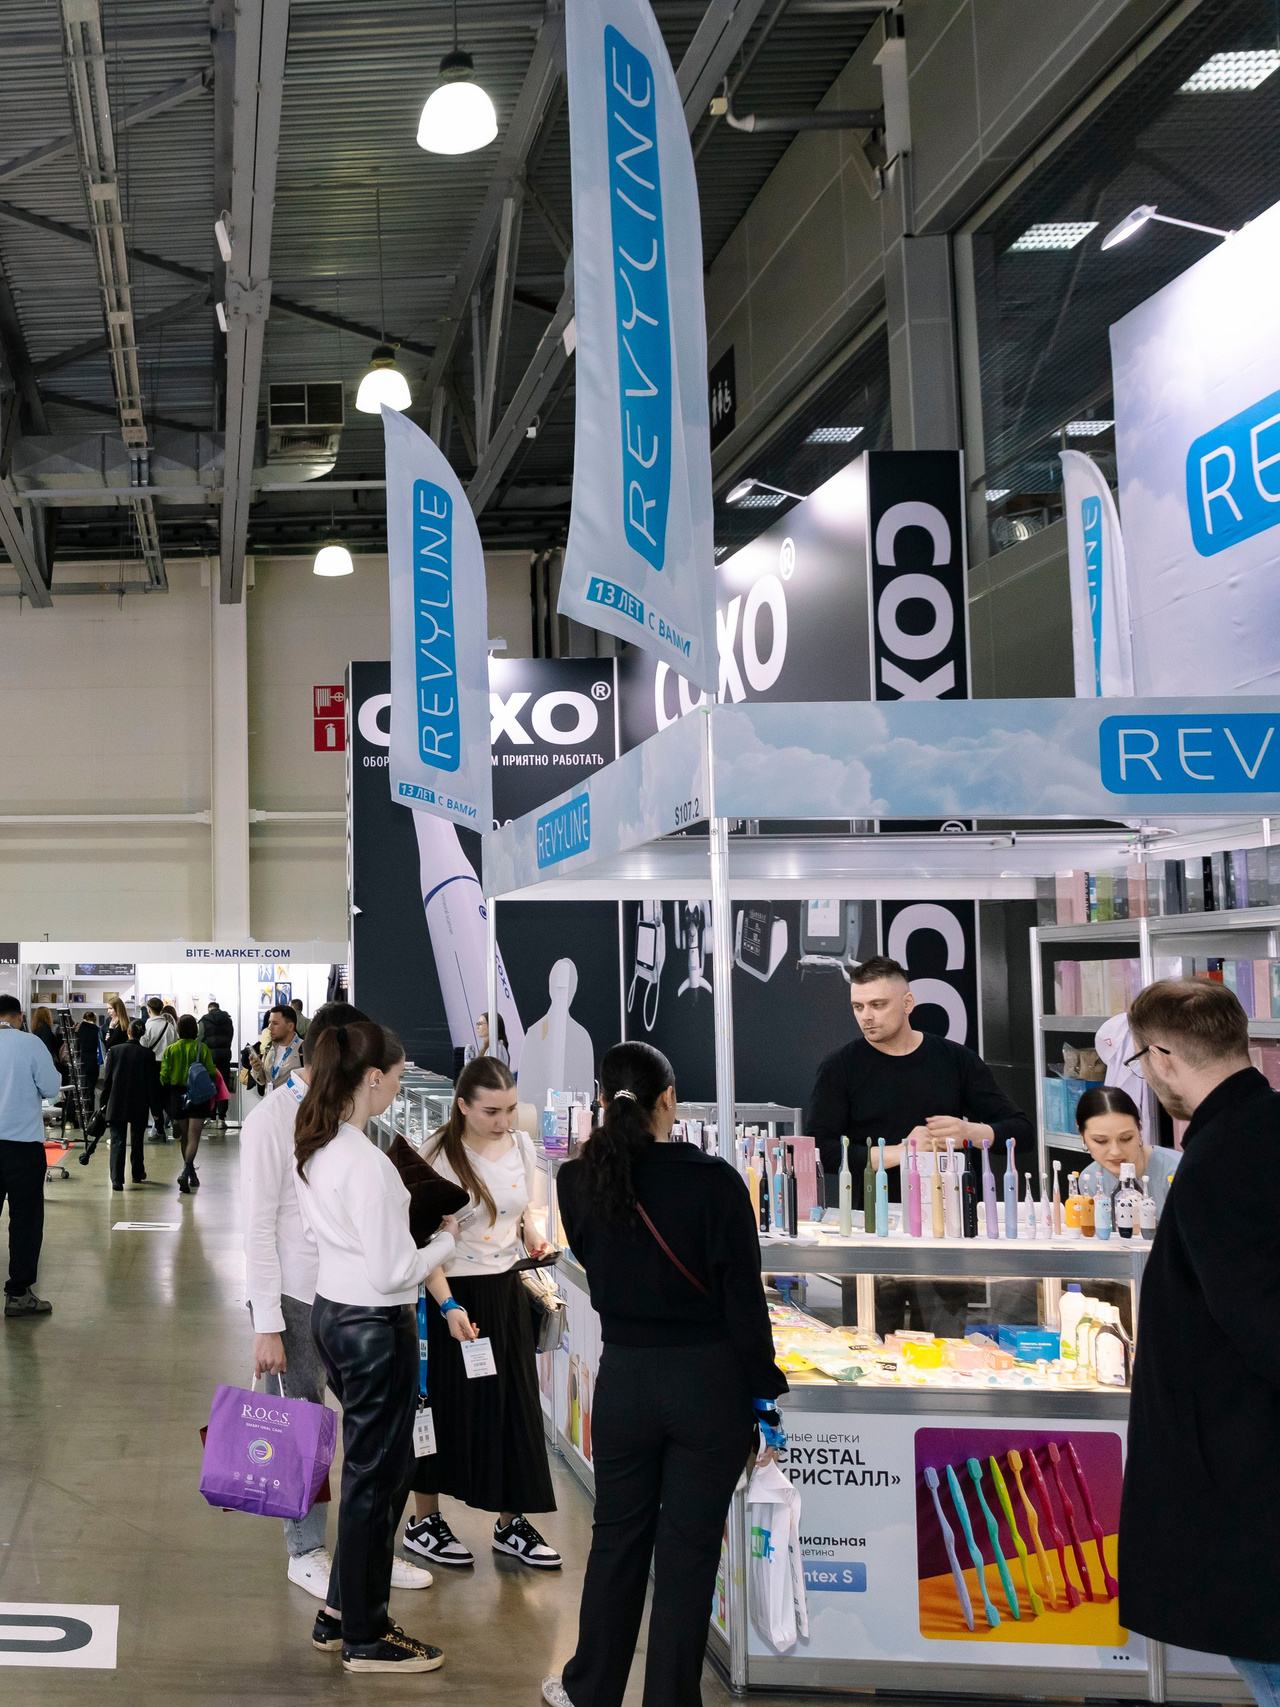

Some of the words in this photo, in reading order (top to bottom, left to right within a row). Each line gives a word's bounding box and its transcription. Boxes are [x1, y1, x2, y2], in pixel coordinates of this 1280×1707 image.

[613, 46, 660, 550] REVYLINE
[419, 488, 454, 761] REVYLINE
[595, 581, 616, 604] 13
[618, 590, 641, 619] ЛЕТ
[648, 612, 656, 631] С
[658, 619, 691, 658] ВАМИ
[357, 690, 599, 748] CXO
[502, 754, 549, 766] ПРИЯТНО
[552, 753, 605, 767] РАБОТАТЬ
[1117, 726, 1275, 782] REV
[401, 783, 414, 796] 13
[416, 787, 434, 802] ЛЕТ
[437, 795, 444, 807] С
[446, 798, 477, 819] ВАМИ
[674, 797, 700, 827] S107.2
[537, 801, 589, 862] REVYLINE
[185, 948, 291, 958] BITE-MARKET.COM
[241, 1403, 291, 1425] R.O.C.S.
[816, 1434, 860, 1445] щетки
[777, 1448, 866, 1466] CRYSTAL
[842, 1569, 854, 1584] S
